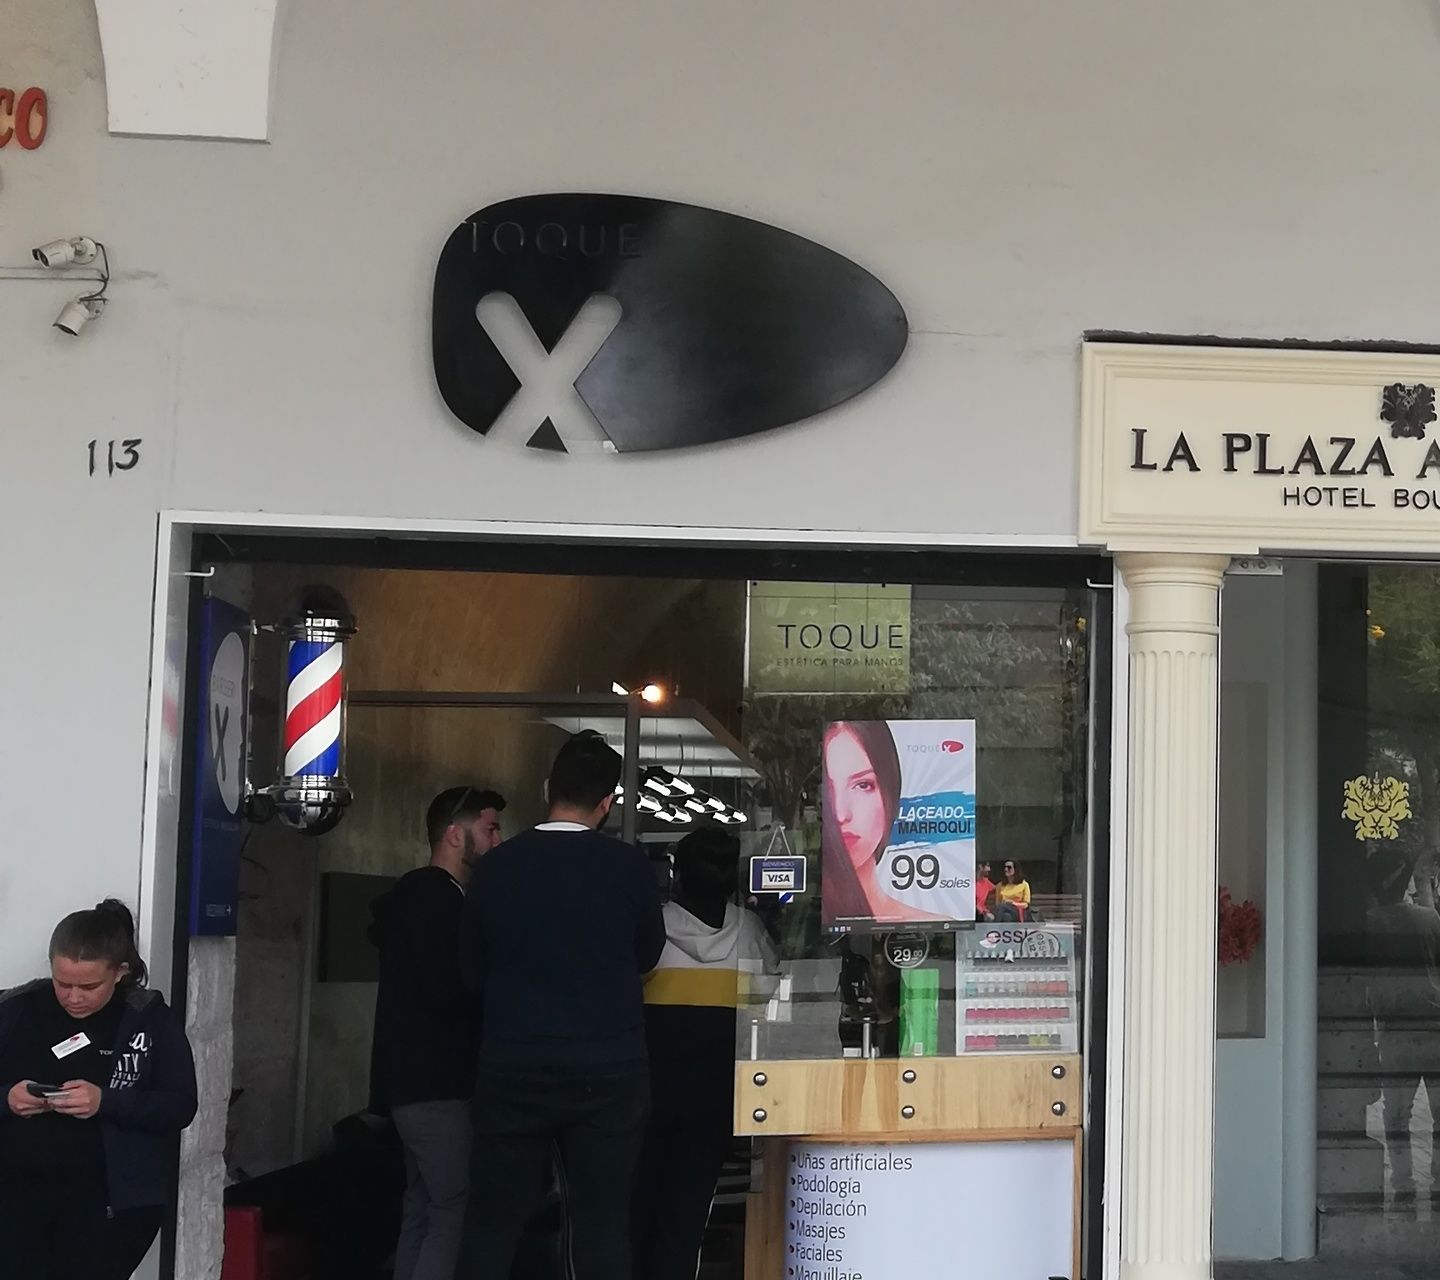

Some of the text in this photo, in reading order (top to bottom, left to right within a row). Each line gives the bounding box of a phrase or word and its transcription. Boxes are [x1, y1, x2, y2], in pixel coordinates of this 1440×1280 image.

[460, 220, 641, 261] TOQUE
[87, 438, 143, 478] 113
[1130, 428, 1201, 473] LA
[1222, 431, 1395, 478] PLAZA
[1282, 486, 1377, 509] HOTEL
[777, 624, 903, 651] TOQUE
[832, 657, 860, 667] PARA
[864, 656, 904, 667] MANOS
[899, 806, 965, 821] LACEADO
[767, 874, 791, 883] VISA
[891, 854, 970, 890] 99 soles
[797, 1152, 912, 1171] Uñas artificiales
[797, 1174, 861, 1198] Podología
[796, 1197, 867, 1218] Depilación
[796, 1219, 846, 1242] Masajes
[796, 1242, 843, 1262] Faciales
